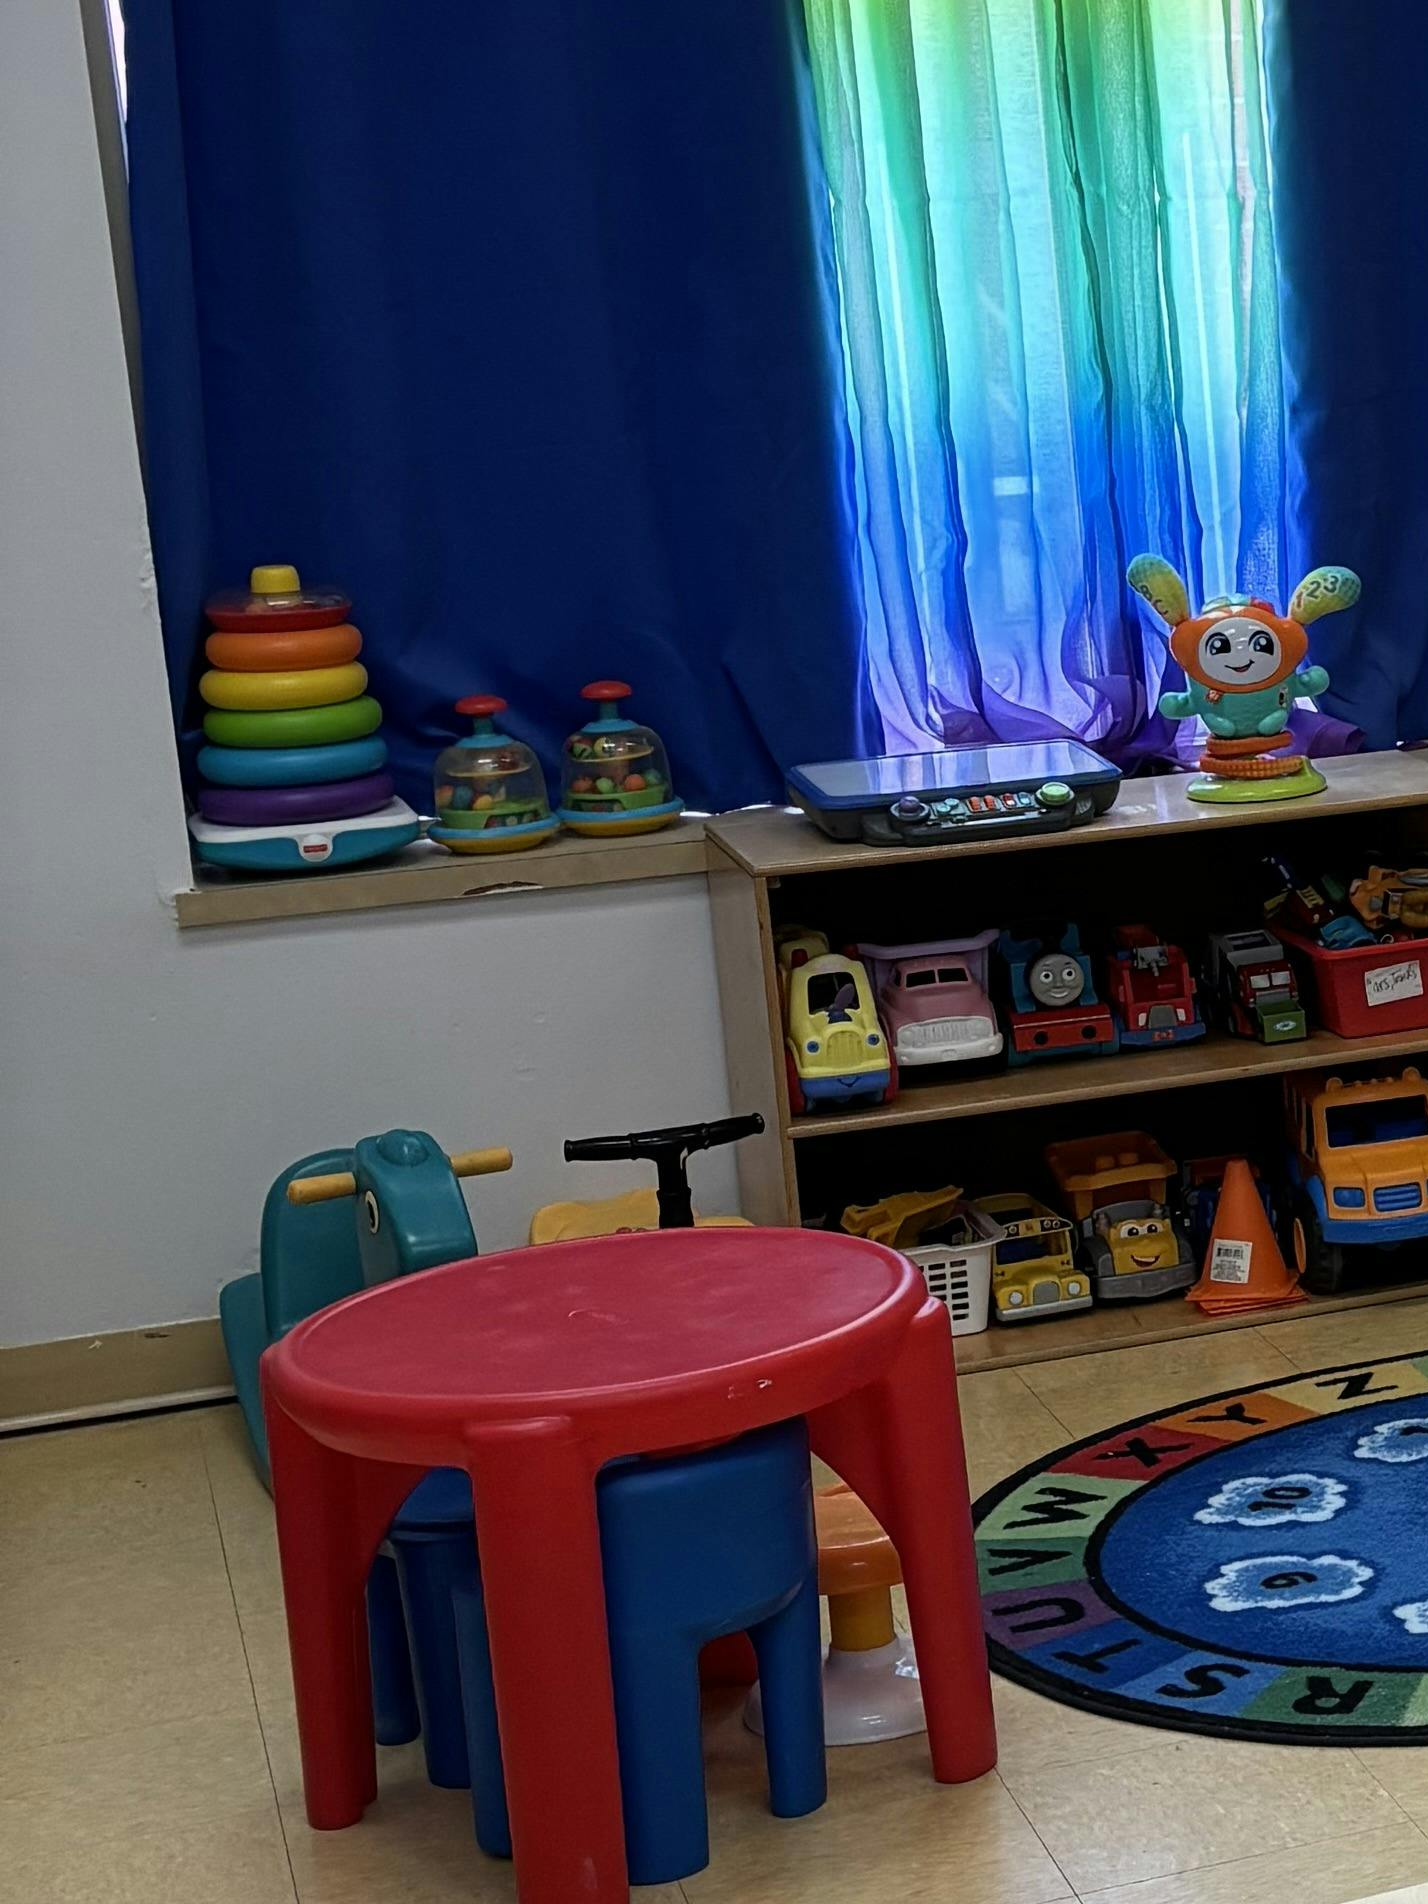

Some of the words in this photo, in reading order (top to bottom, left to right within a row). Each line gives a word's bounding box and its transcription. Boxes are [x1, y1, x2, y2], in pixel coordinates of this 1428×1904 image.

[1315, 1371, 1399, 1399] Z
[1187, 1402, 1267, 1426] Y
[1093, 1436, 1195, 1467] X
[1002, 1486, 1107, 1530] W
[1247, 1485, 1310, 1513] 10
[987, 1548, 1072, 1576] V
[1261, 1571, 1318, 1590] 9
[991, 1597, 1085, 1634] U
[1053, 1639, 1142, 1675] T
[1156, 1663, 1250, 1698] S
[1293, 1676, 1374, 1715] R
